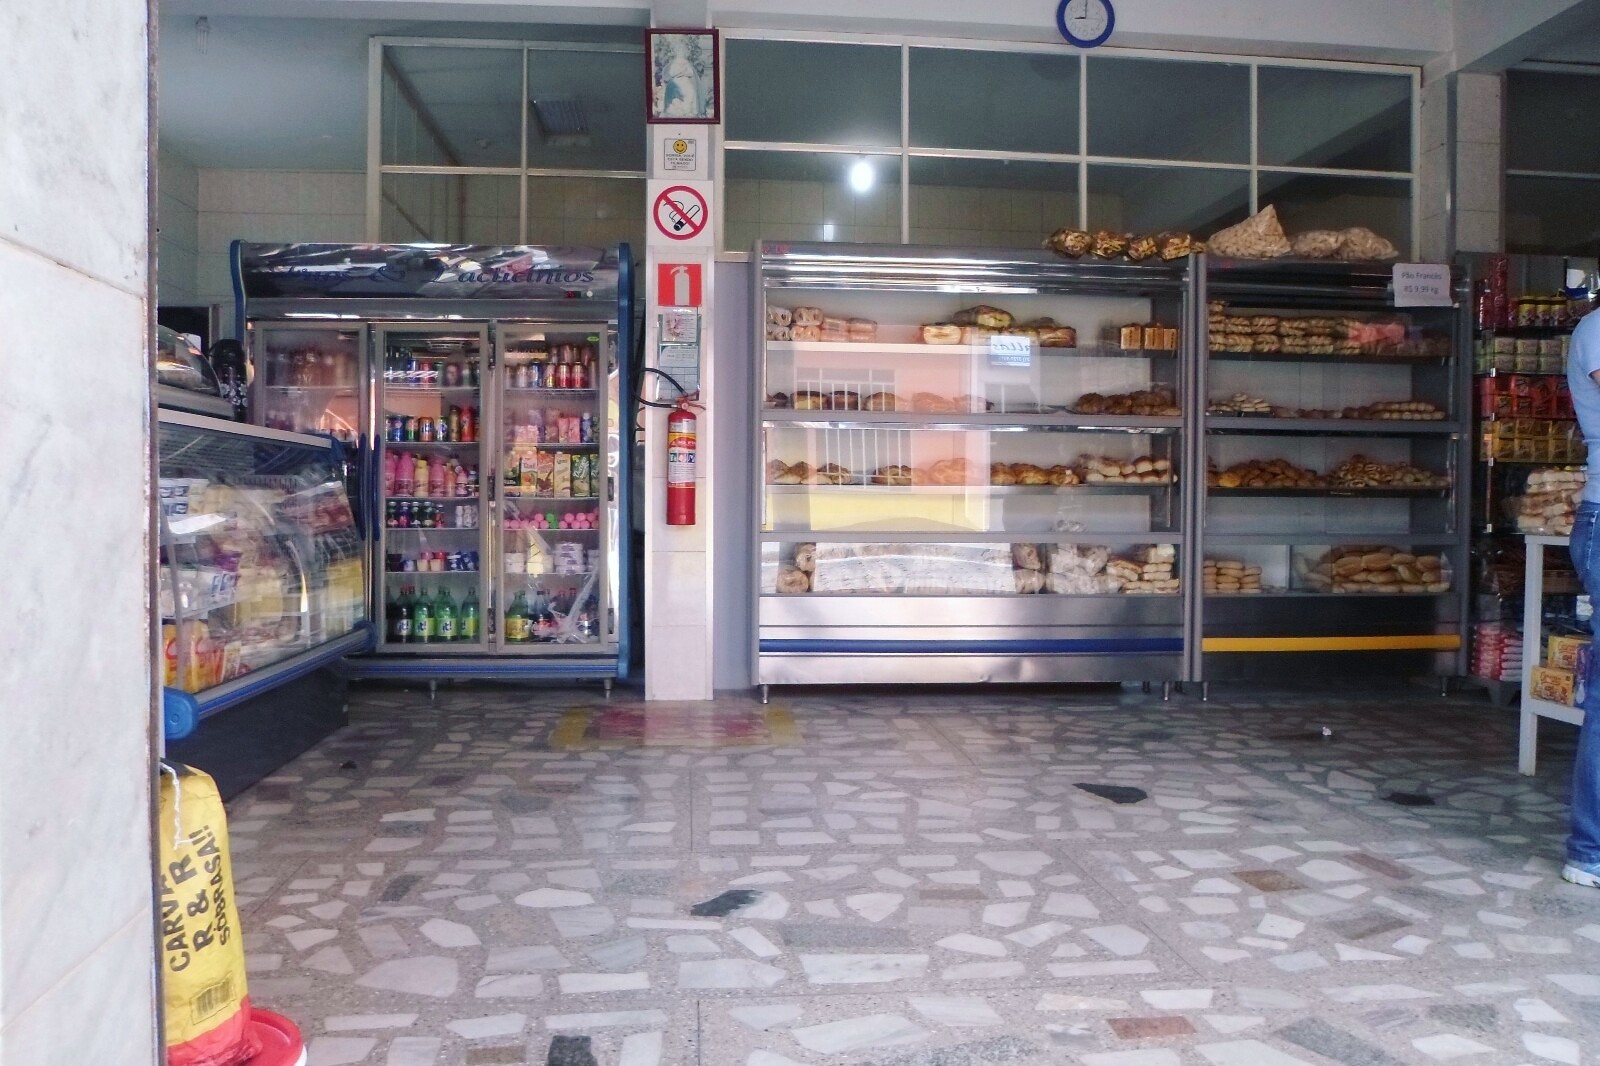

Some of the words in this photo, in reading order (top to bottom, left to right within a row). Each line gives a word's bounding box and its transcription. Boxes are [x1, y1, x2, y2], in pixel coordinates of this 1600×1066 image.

[168, 854, 198, 885] R
[186, 888, 210, 918] &
[192, 921, 214, 952] R
